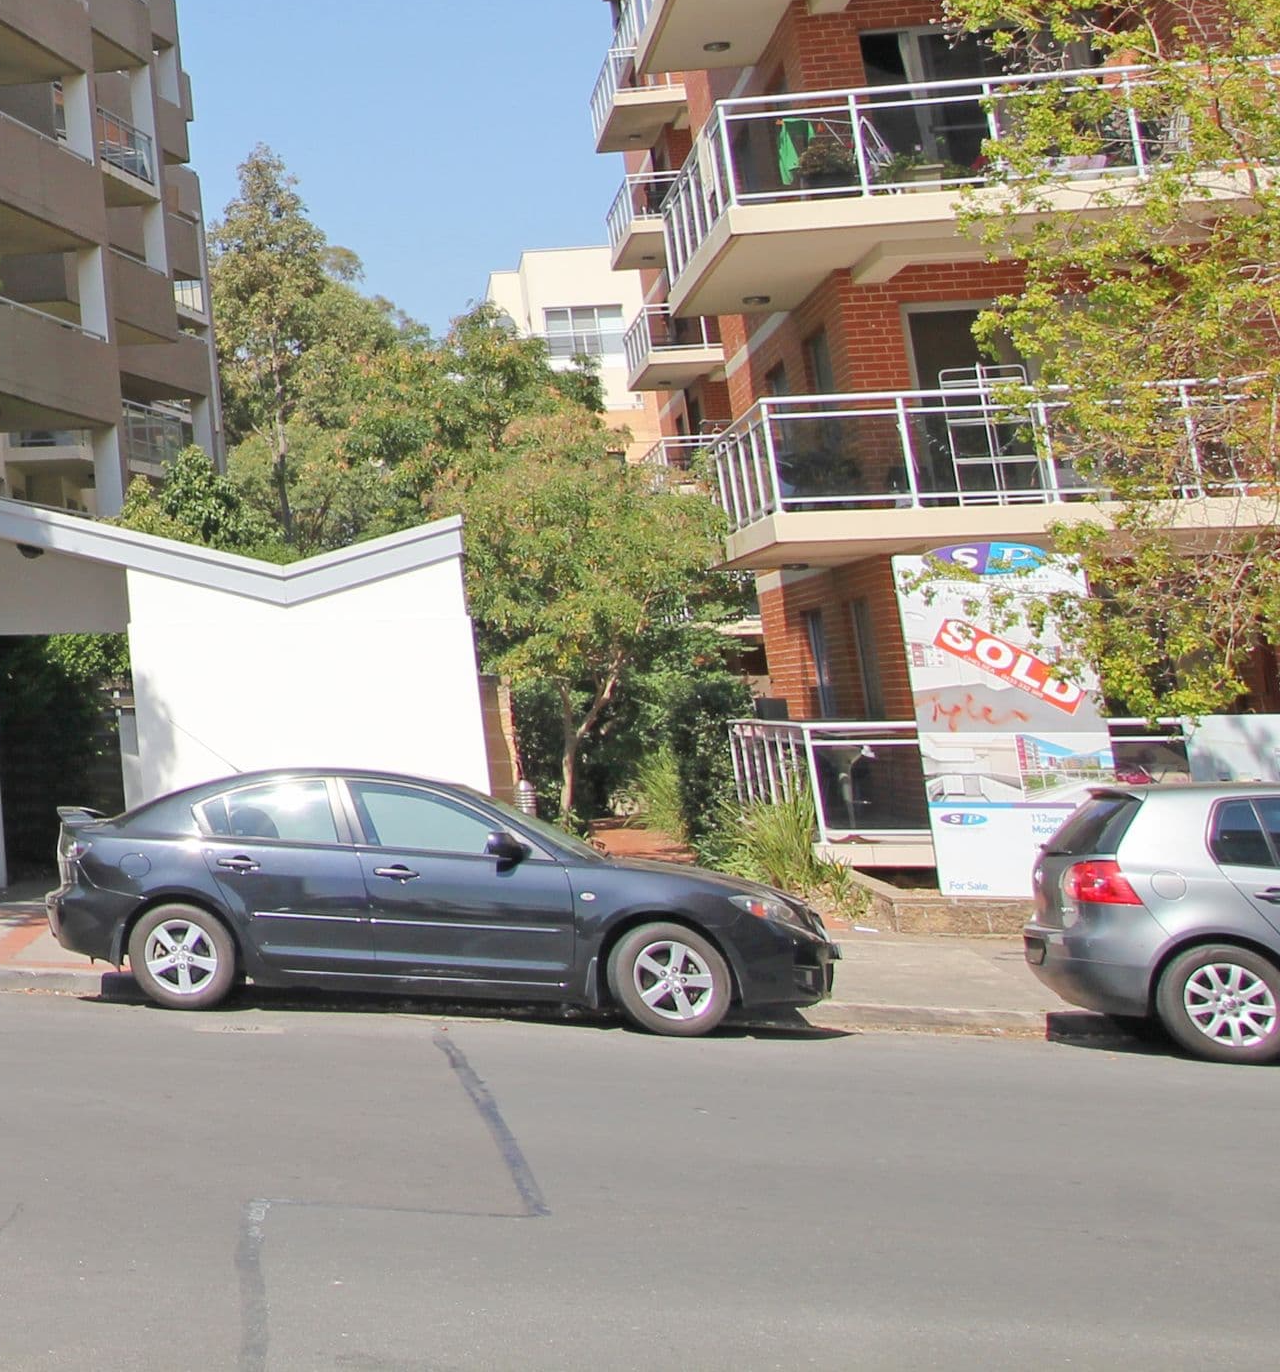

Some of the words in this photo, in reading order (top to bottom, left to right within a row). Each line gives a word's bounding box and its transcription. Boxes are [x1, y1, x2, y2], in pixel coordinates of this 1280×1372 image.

[941, 620, 1081, 704] SOLD
[949, 880, 966, 890] For
[967, 880, 989, 891] Sale
